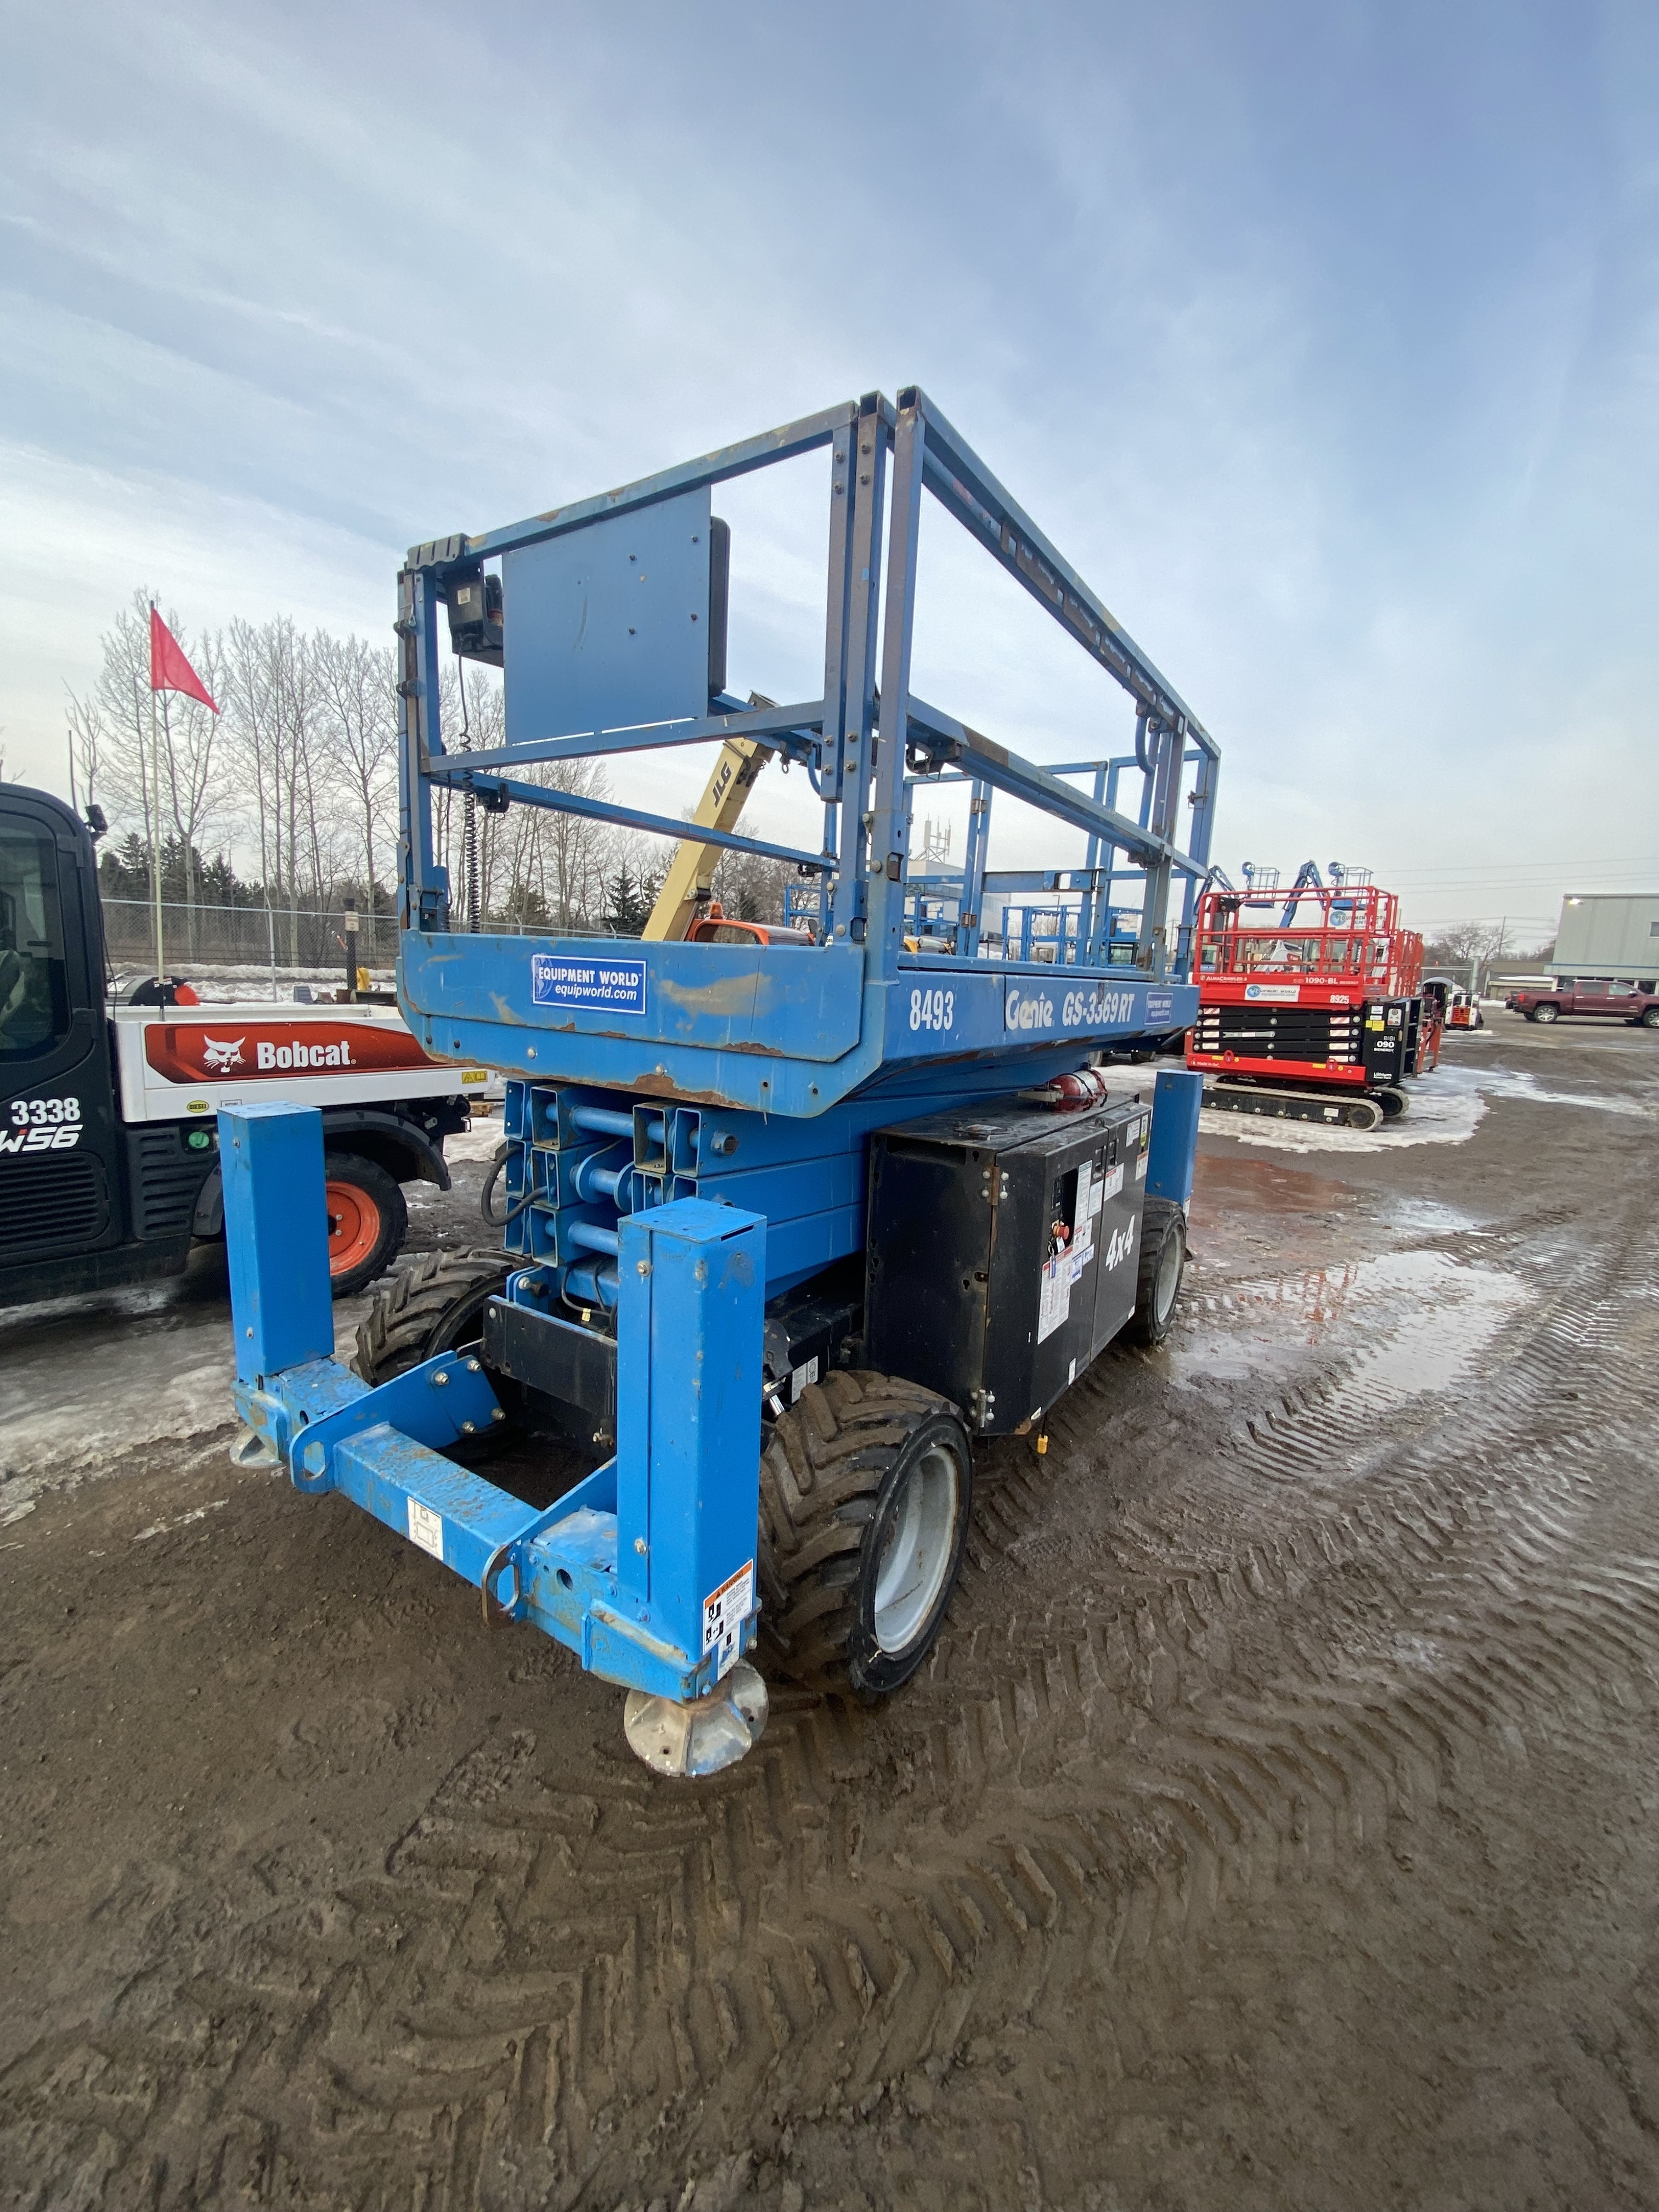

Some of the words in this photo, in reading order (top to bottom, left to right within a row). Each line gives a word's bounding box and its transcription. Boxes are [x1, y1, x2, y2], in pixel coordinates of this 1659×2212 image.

[712, 761, 732, 808] JLG
[538, 967, 595, 984] EQUIPMENT
[599, 970, 639, 987] WORLD
[555, 983, 637, 1001] equipworld.com
[1329, 994, 1350, 1005] 8925
[909, 989, 954, 1031] 8493
[1006, 989, 1054, 1030] Genie
[257, 1040, 351, 1069] Bobcat
[11, 1097, 81, 1125] 3338
[1105, 1214, 1135, 1272] 4x4
[721, 1570, 744, 1593] WARNING
